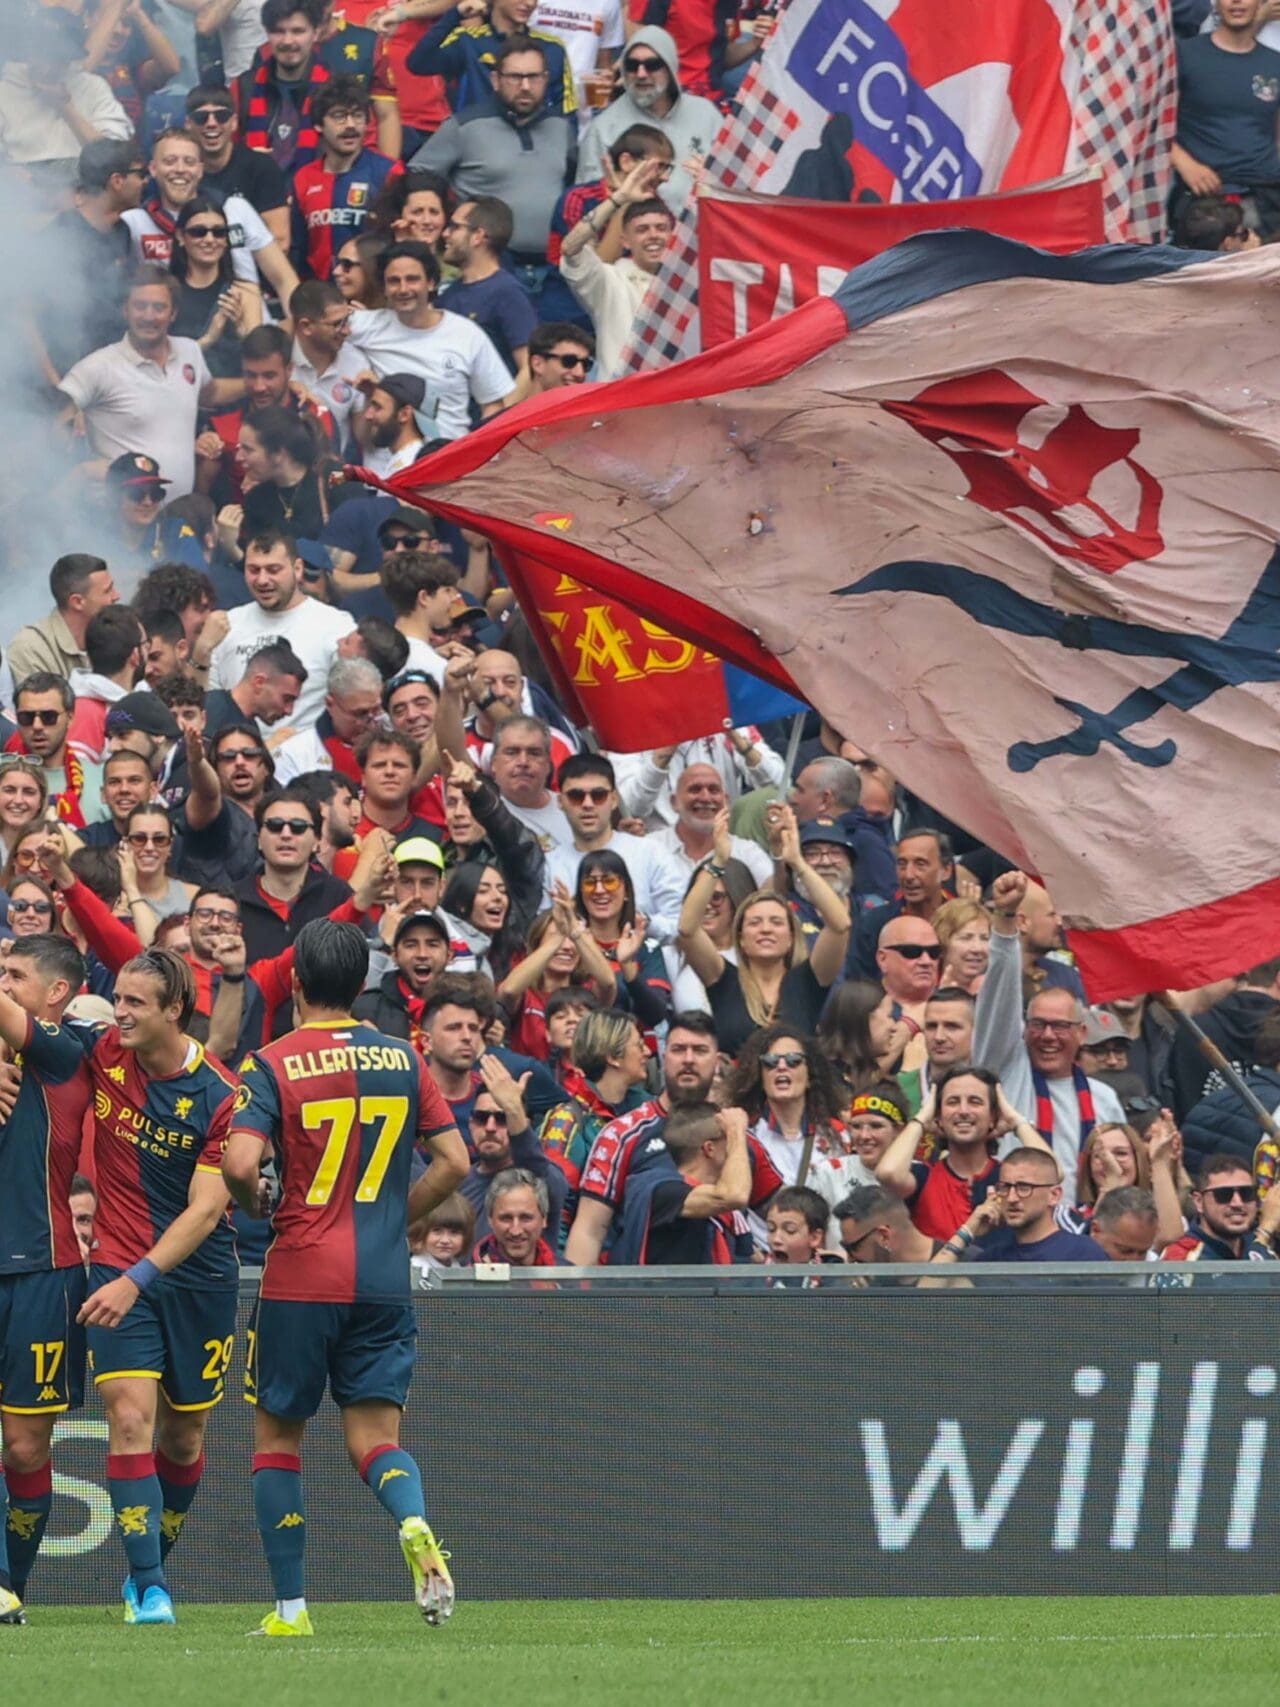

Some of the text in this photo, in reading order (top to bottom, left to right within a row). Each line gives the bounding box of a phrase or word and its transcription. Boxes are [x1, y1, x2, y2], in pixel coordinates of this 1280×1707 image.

[283, 1046, 410, 1081] ELLERTSSON
[115, 1126, 139, 1144] Luce
[118, 1107, 193, 1150] PULSEE
[302, 1096, 408, 1205] 77
[30, 1341, 64, 1384] 17
[202, 1335, 234, 1379] 29
